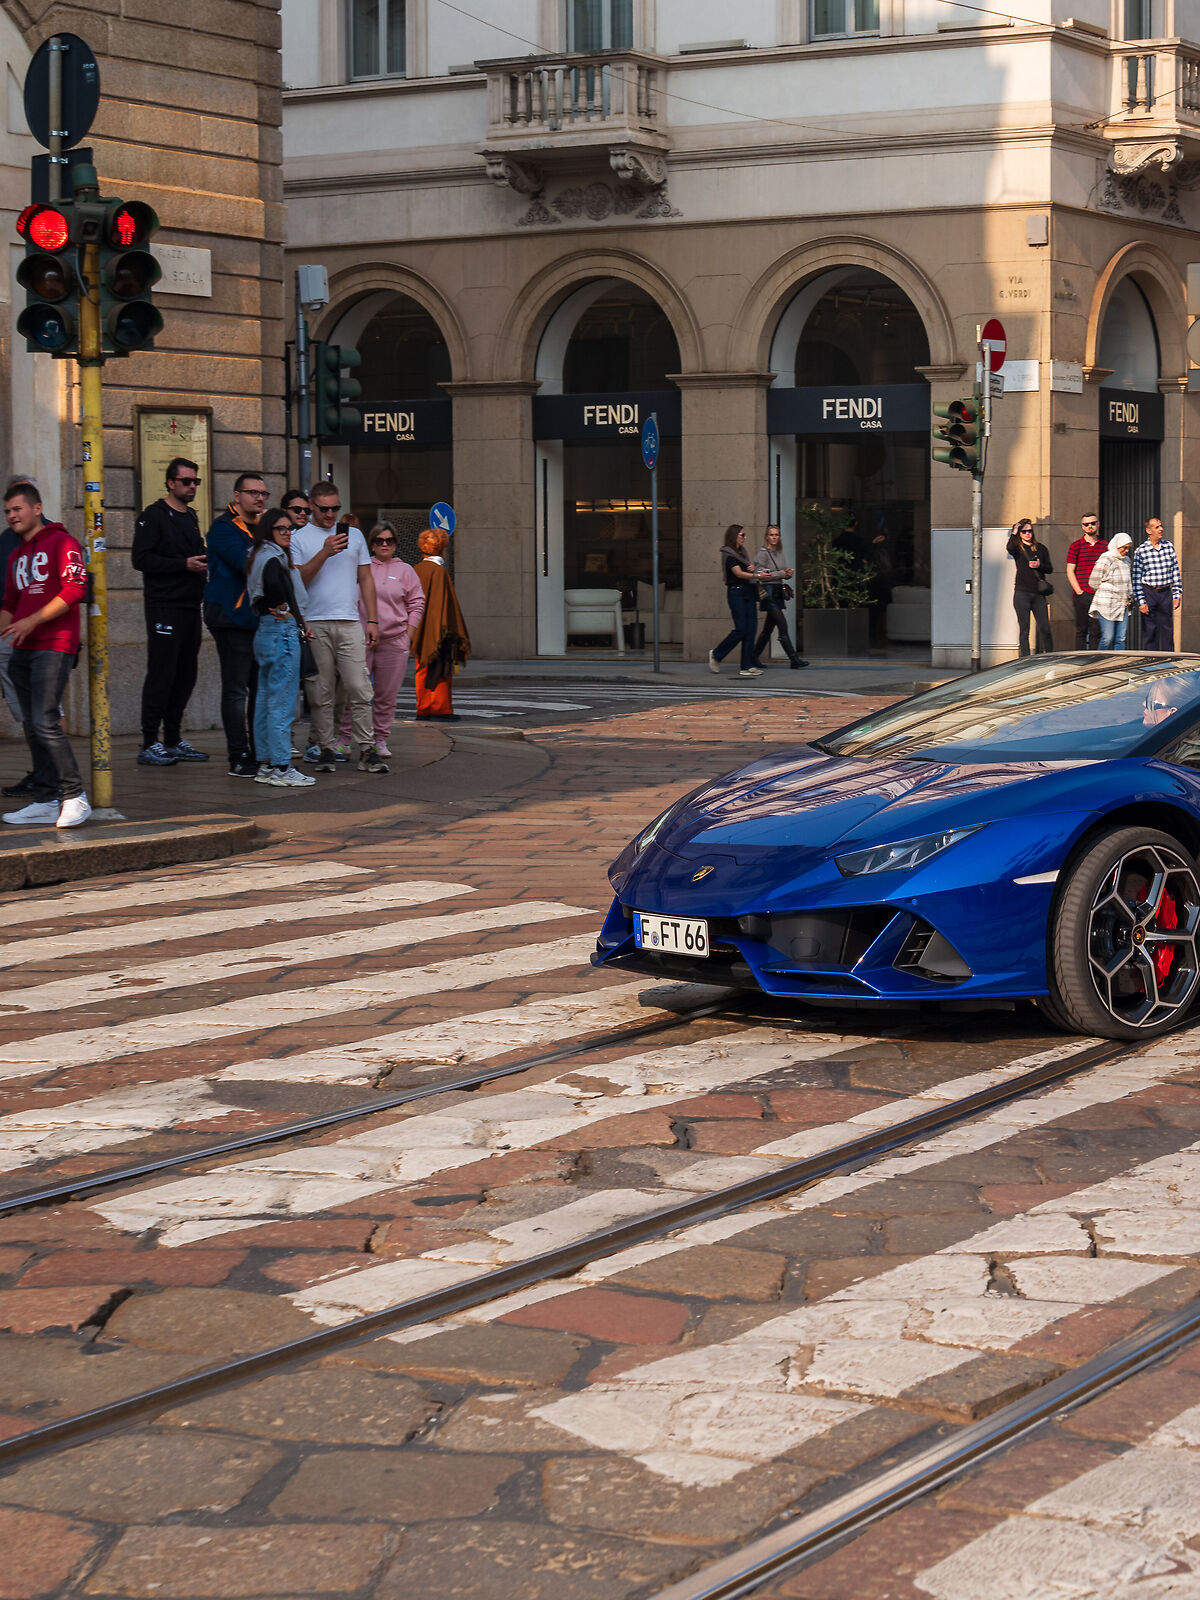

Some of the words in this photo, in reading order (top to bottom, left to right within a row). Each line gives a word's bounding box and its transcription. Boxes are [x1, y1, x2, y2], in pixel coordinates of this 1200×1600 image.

[1008, 276, 1023, 286] VIA
[584, 404, 639, 425] FENDI
[823, 397, 882, 419] FENDI
[1109, 401, 1139, 423] FENDI
[364, 412, 415, 433] FENDI
[618, 426, 640, 434] CASA
[860, 420, 883, 429] CASA
[396, 433, 416, 441] CASA
[641, 918, 650, 944] F
